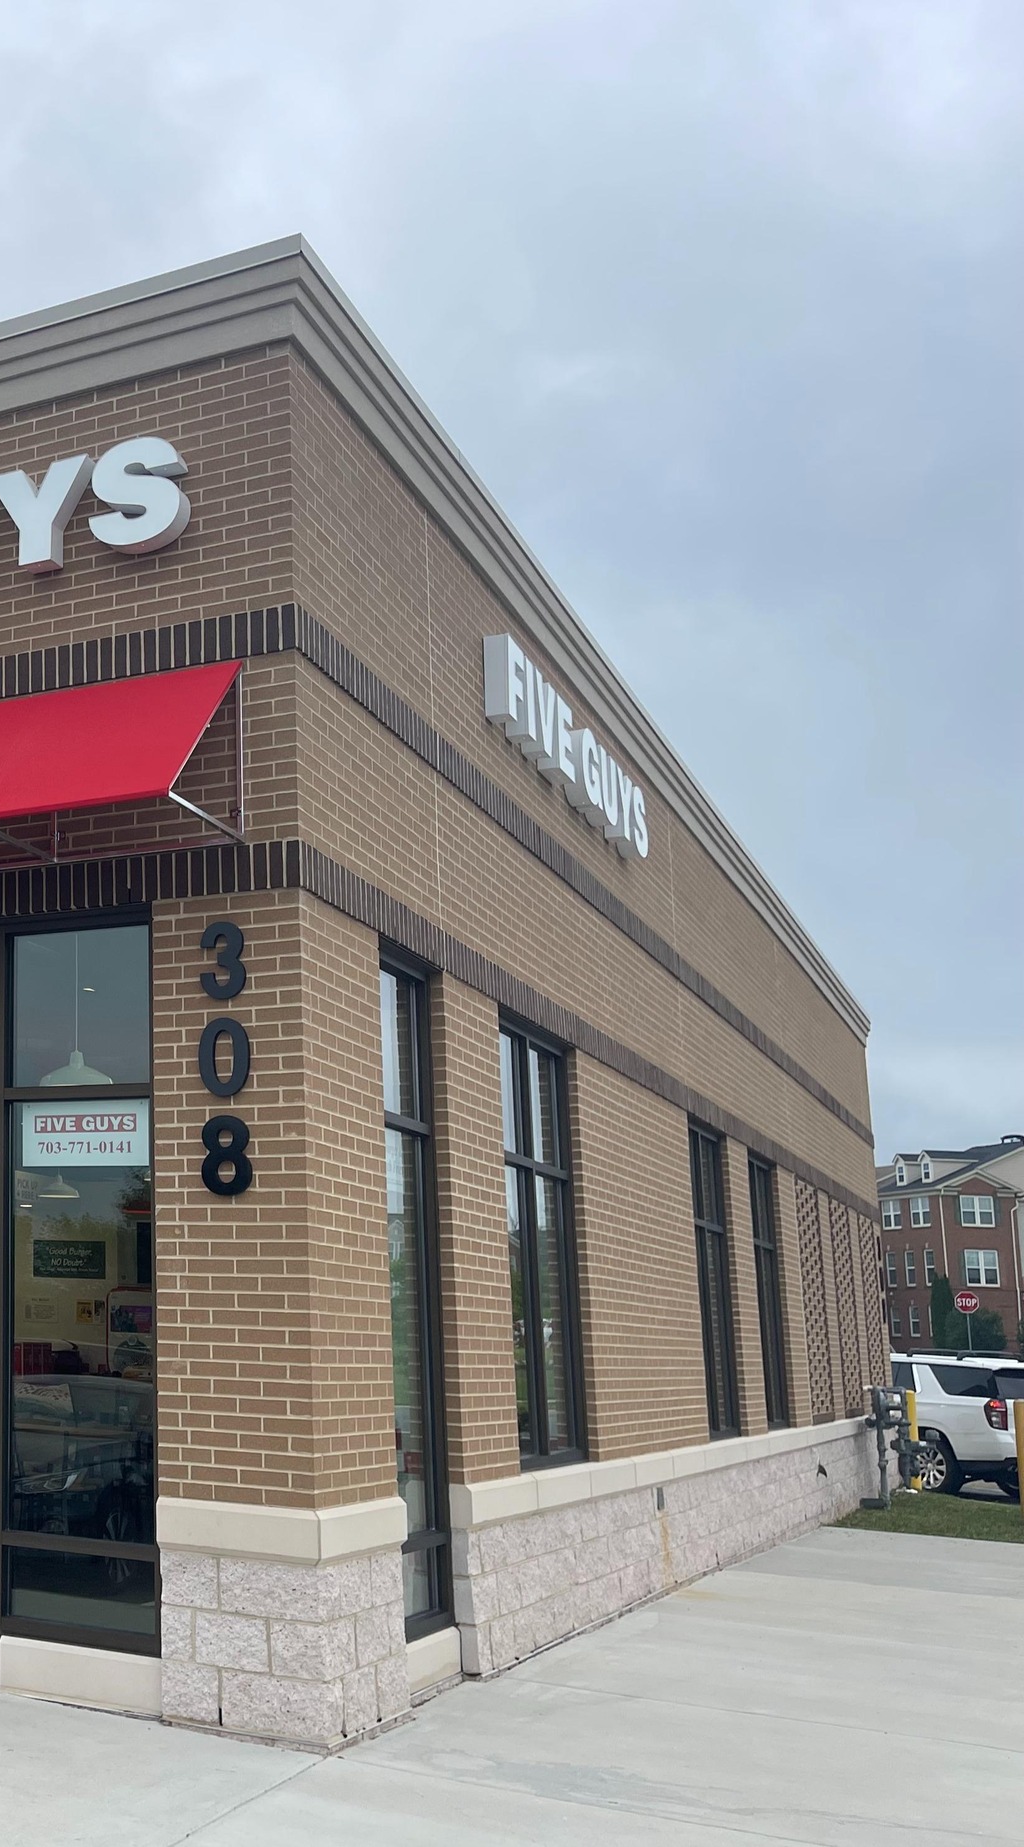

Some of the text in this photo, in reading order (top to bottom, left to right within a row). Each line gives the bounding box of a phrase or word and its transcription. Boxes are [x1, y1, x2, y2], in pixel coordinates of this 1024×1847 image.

[484, 634, 649, 858] FIVE GUYS
[198, 921, 253, 1196] 308
[36, 1115, 135, 1132] FIVE GUYS
[37, 1140, 133, 1154] 703-771-0141
[956, 1298, 977, 1307] STOP
